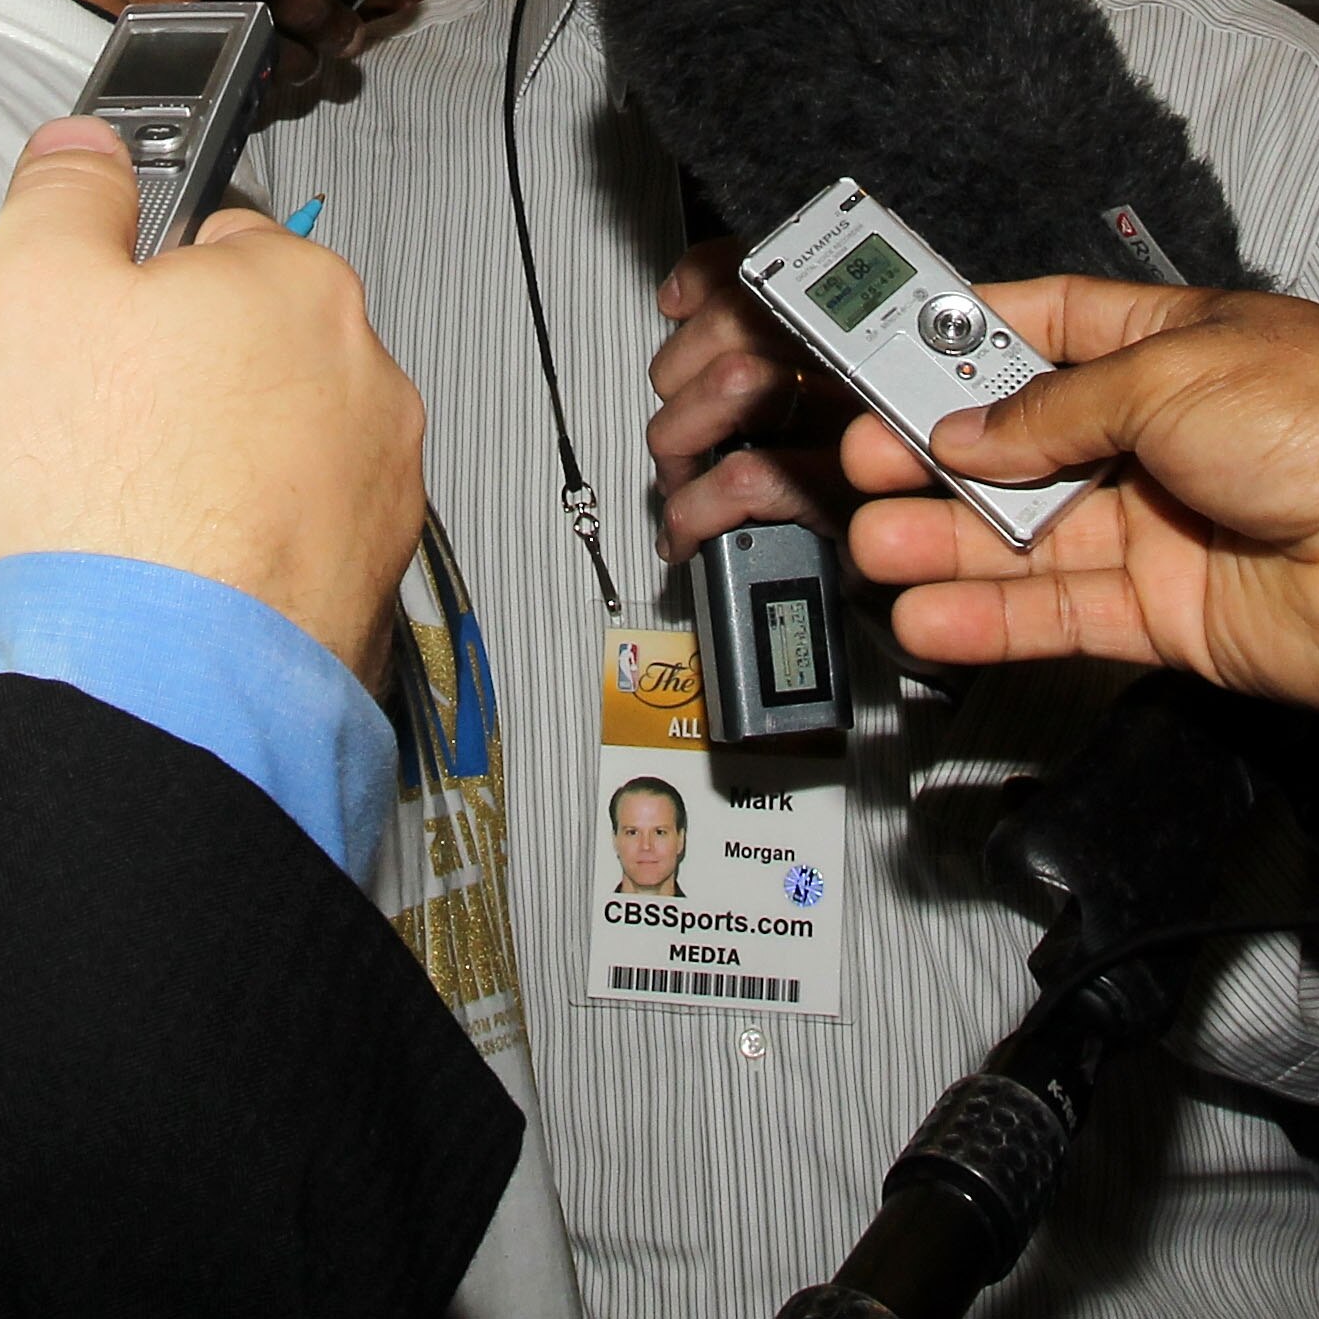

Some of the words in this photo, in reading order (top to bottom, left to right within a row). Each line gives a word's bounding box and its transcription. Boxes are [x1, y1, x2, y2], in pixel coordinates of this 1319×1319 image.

[792, 219, 851, 269] OLYMPUS
[638, 661, 697, 694] The
[667, 715, 703, 739] ALL
[729, 786, 794, 812] Mark
[724, 841, 796, 864] Morgan
[603, 900, 814, 938] CBSSports.com
[668, 943, 742, 967] MEDIA
